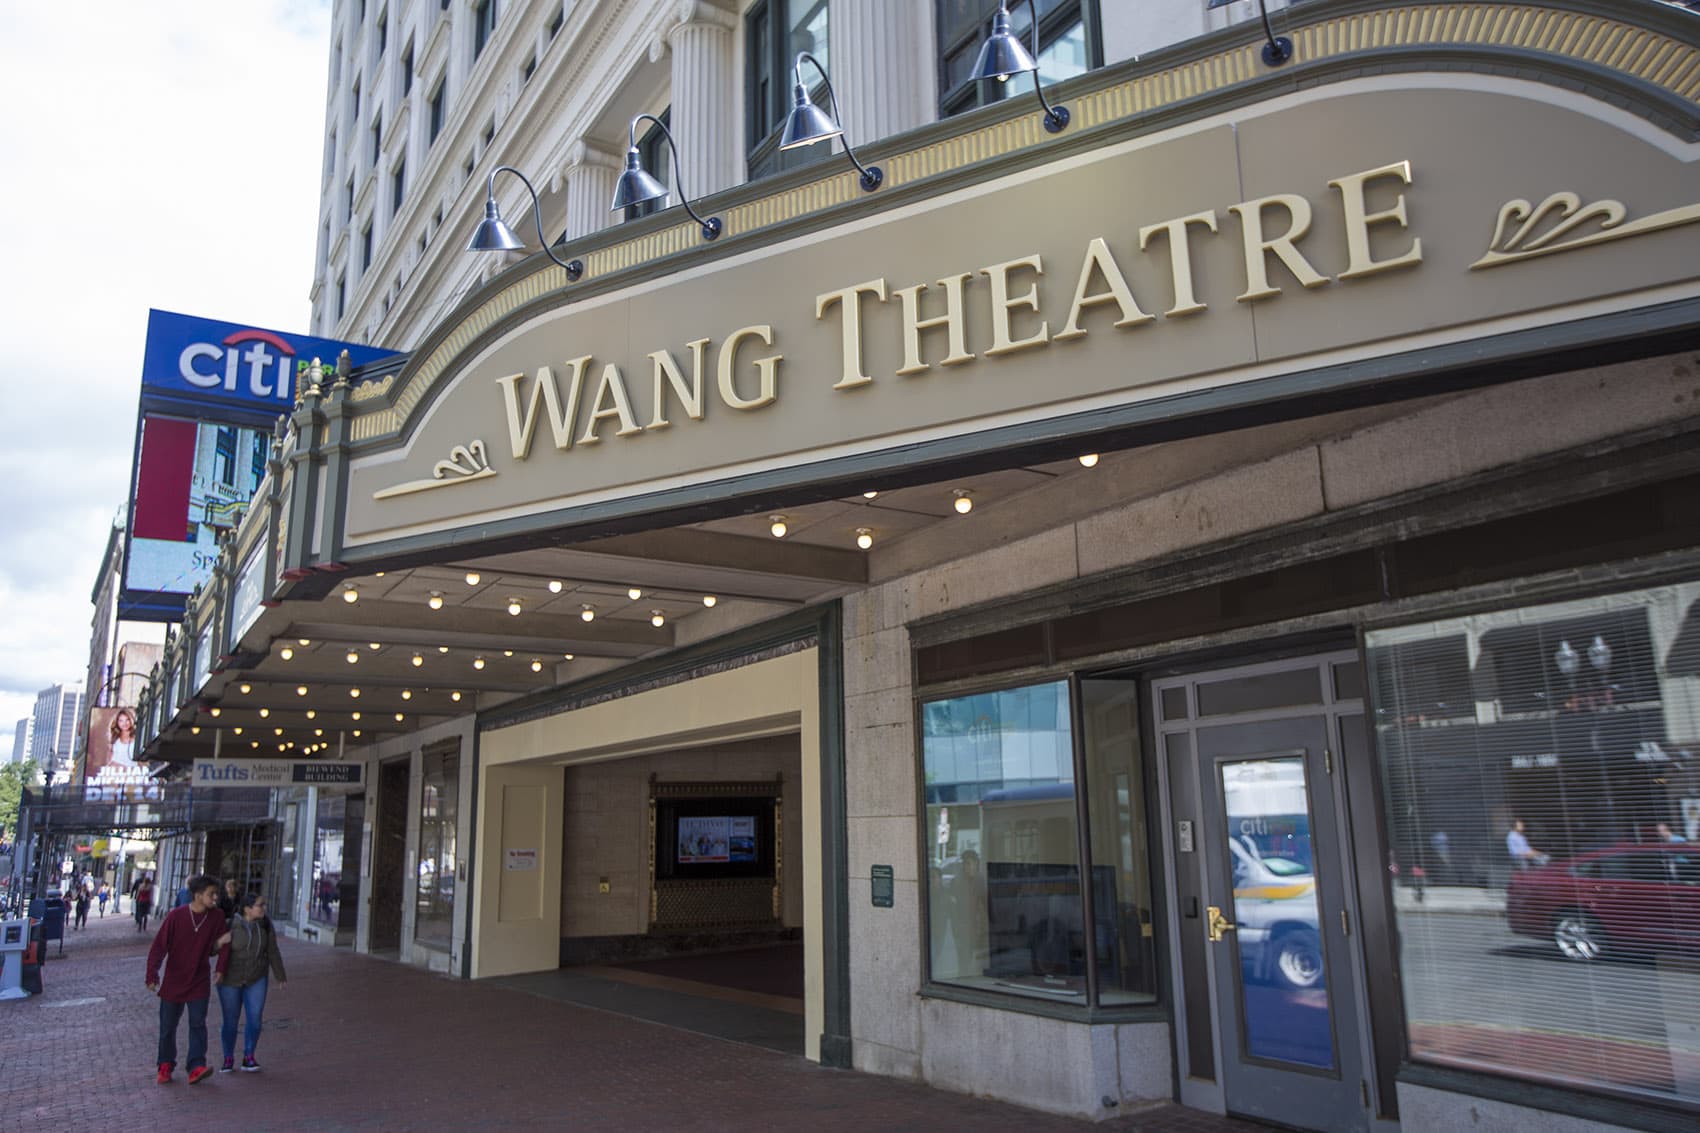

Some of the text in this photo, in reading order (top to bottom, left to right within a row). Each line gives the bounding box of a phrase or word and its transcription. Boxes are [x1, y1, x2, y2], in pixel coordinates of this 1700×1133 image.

[496, 160, 1423, 460] WANG THEATRE
[178, 341, 291, 399] citi
[198, 763, 249, 780] Tufts
[252, 763, 290, 774] Medical
[305, 773, 349, 781] BUILDING
[1240, 816, 1267, 835] citi
